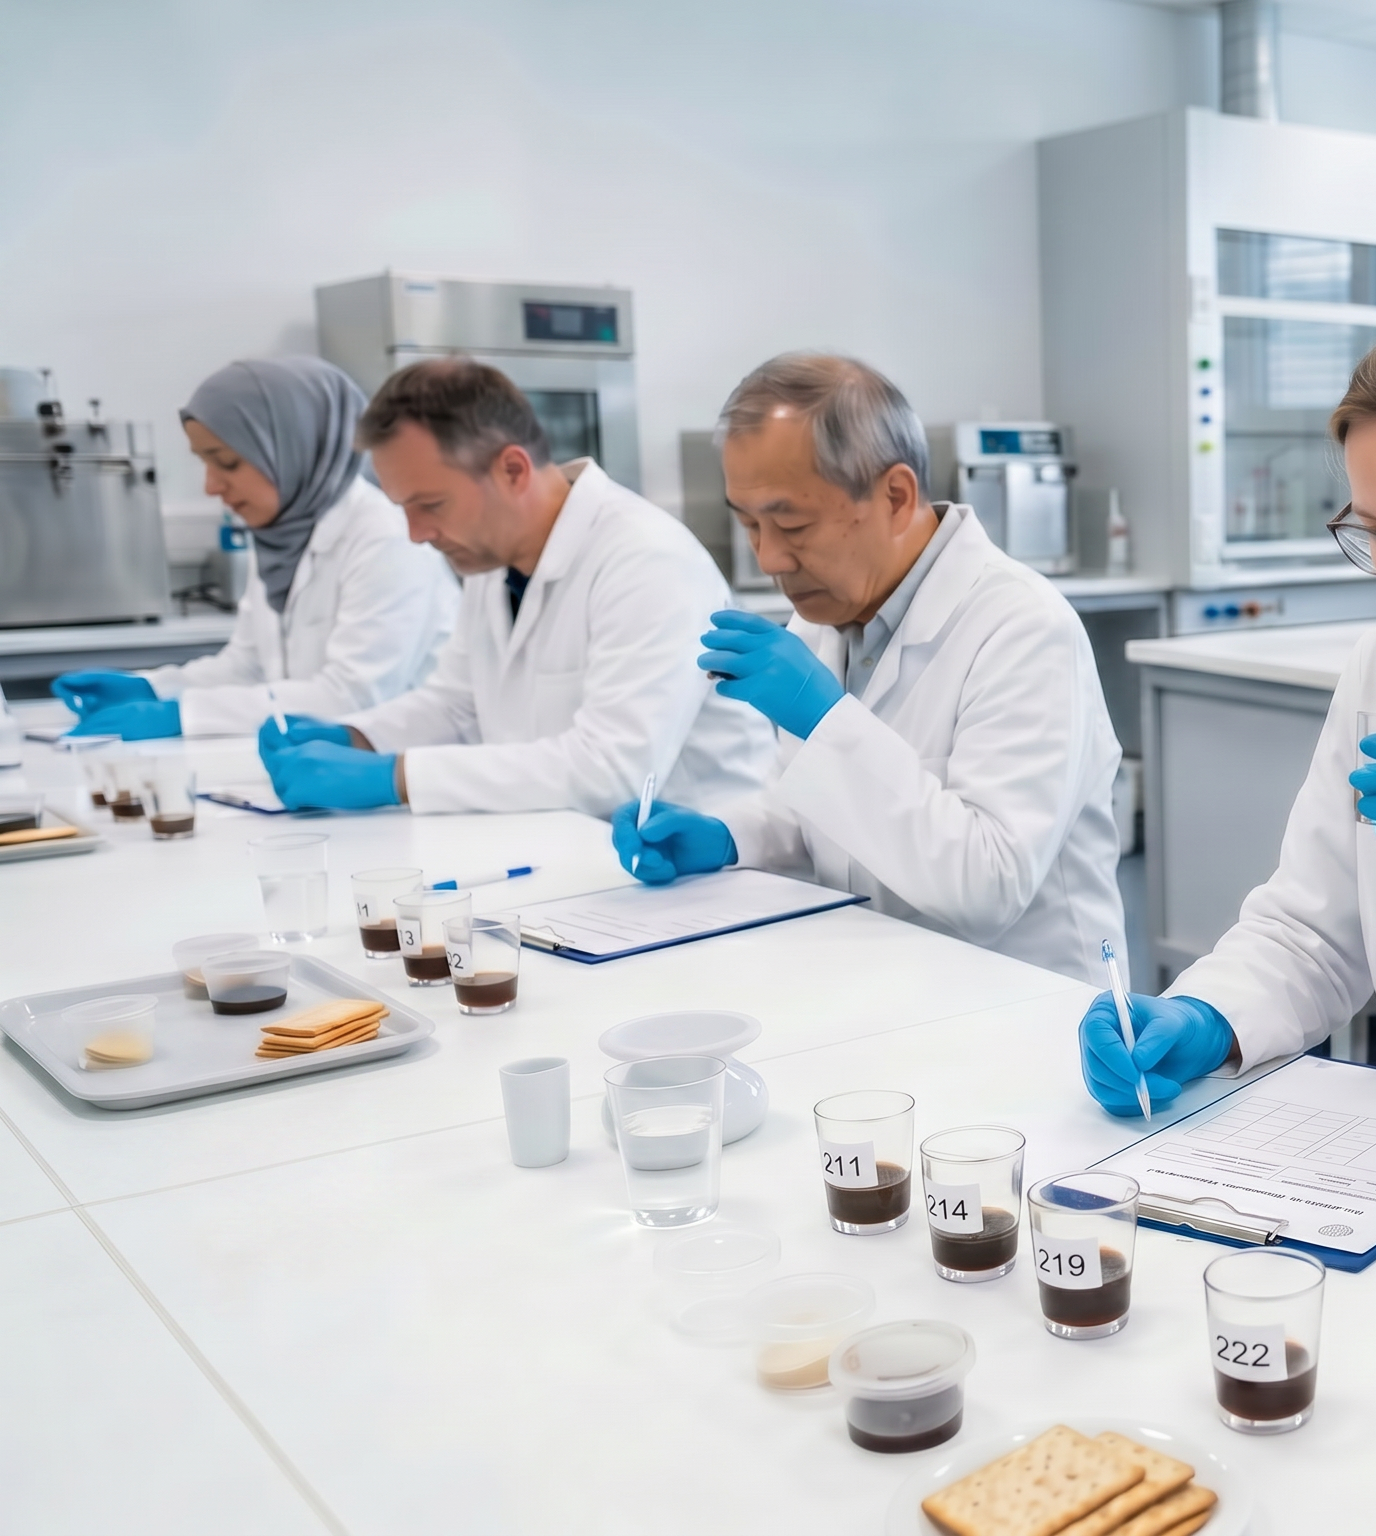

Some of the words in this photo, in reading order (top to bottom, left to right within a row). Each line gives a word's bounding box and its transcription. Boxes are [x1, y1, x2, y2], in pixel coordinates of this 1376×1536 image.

[823, 1152, 860, 1177] 211
[927, 1194, 969, 1221] 214
[1038, 1248, 1085, 1277] 219
[1216, 1335, 1270, 1368] 222
